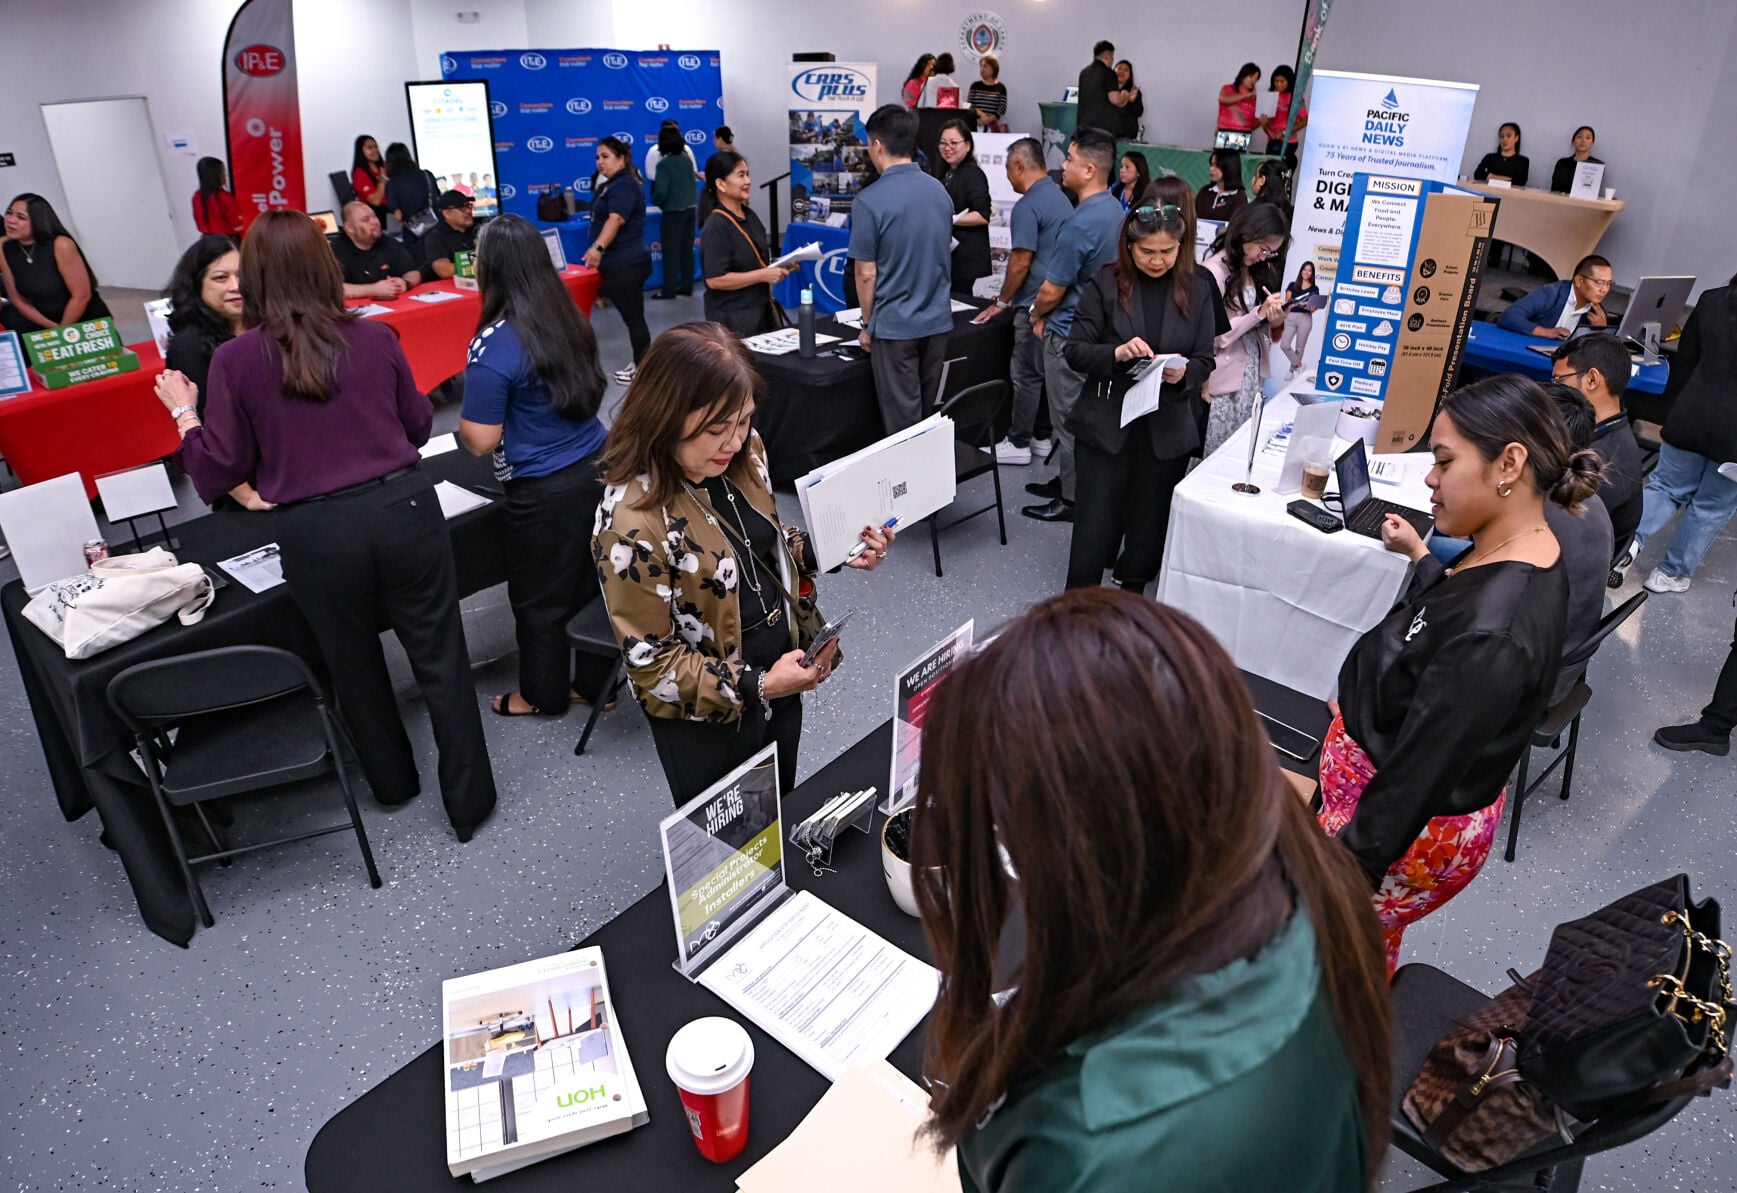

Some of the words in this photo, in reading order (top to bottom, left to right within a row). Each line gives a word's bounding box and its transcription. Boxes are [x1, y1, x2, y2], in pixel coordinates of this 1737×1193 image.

[242, 52, 280, 71] IP&E
[804, 73, 855, 85] CARS
[817, 84, 867, 101] PLUS
[1366, 109, 1410, 122] PACIFIC
[1364, 120, 1407, 134] DAILY
[1362, 133, 1405, 147] NEWS
[1326, 151, 1335, 159] 75
[1337, 152, 1356, 161] Years
[1357, 155, 1366, 164] of
[1367, 156, 1394, 166] Trusted
[1374, 148, 1396, 156] DIGITAL
[1418, 153, 1448, 162] PLATFORM
[1319, 168, 1336, 177] Turn
[1337, 170, 1354, 178] Crea
[1316, 180, 1353, 196] DIGI
[1373, 180, 1415, 192] MISSION
[1381, 199, 1407, 207] Connect
[1308, 225, 1327, 233] News
[1356, 269, 1401, 282] BENEFITS
[1448, 310, 1468, 372] Presentation
[1463, 278, 1477, 308] Board
[51, 345, 75, 360] EAT
[75, 336, 115, 355] FRESH
[906, 671, 920, 689] WE
[920, 660, 937, 679] ARE
[938, 639, 965, 664] HIRING
[913, 677, 928, 692] OPEN
[705, 784, 741, 821] WE'RE
[706, 799, 744, 838] HIRING
[691, 863, 728, 900] Special
[729, 836, 768, 873] Projects
[698, 850, 764, 906] Administrator
[704, 869, 756, 916] Installers
